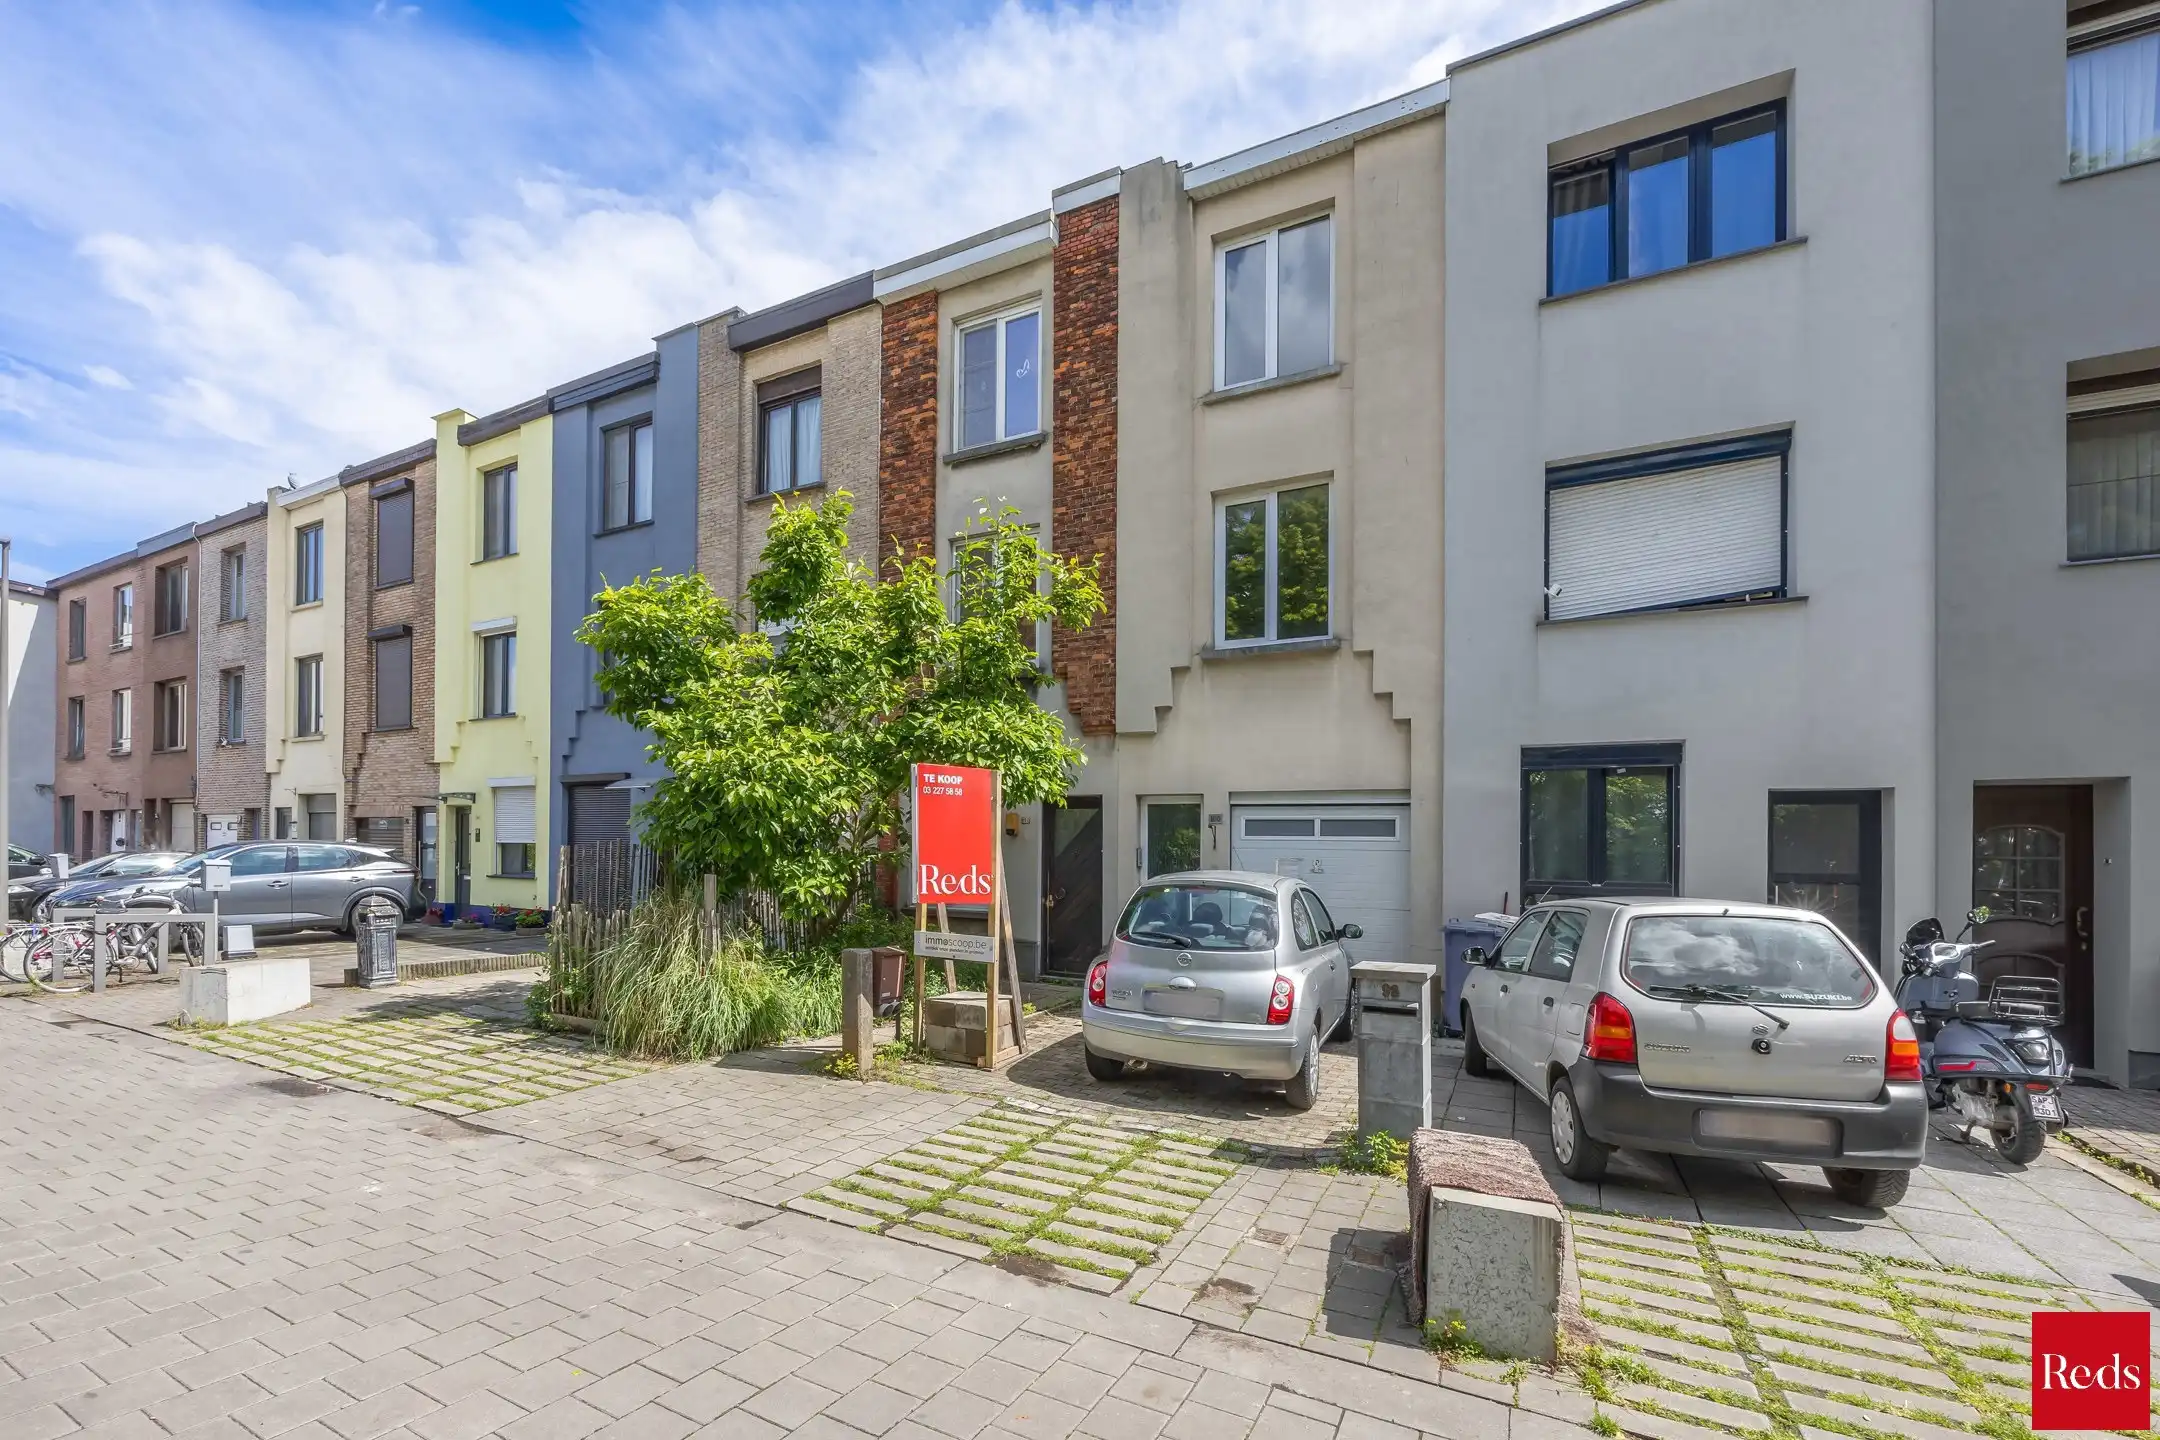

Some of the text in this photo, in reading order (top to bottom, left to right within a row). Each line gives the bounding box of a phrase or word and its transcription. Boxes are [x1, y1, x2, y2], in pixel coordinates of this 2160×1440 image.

[923, 773, 963, 785] TE KOOP
[923, 786, 932, 795] 03
[933, 786, 945, 795] 227
[920, 864, 991, 896] Reds
[925, 935, 987, 950] immoscoop.be
